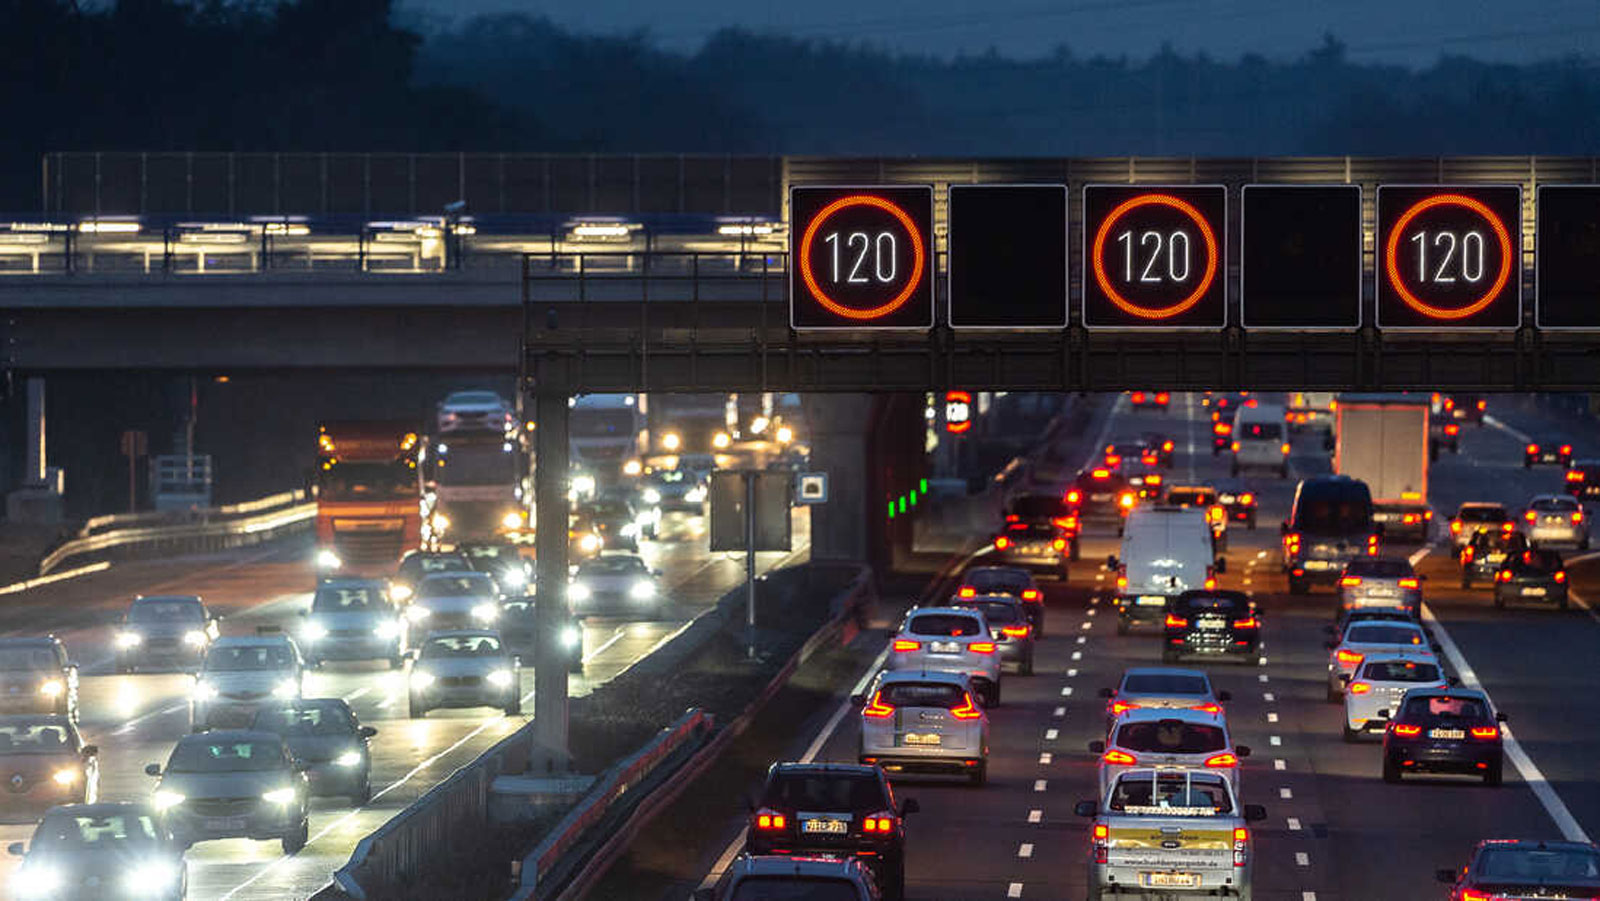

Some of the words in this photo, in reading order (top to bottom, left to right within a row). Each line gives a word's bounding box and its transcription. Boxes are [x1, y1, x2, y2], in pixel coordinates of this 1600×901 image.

[826, 231, 895, 283] 120
[1119, 230, 1188, 282] 120
[1412, 231, 1483, 283] 120
